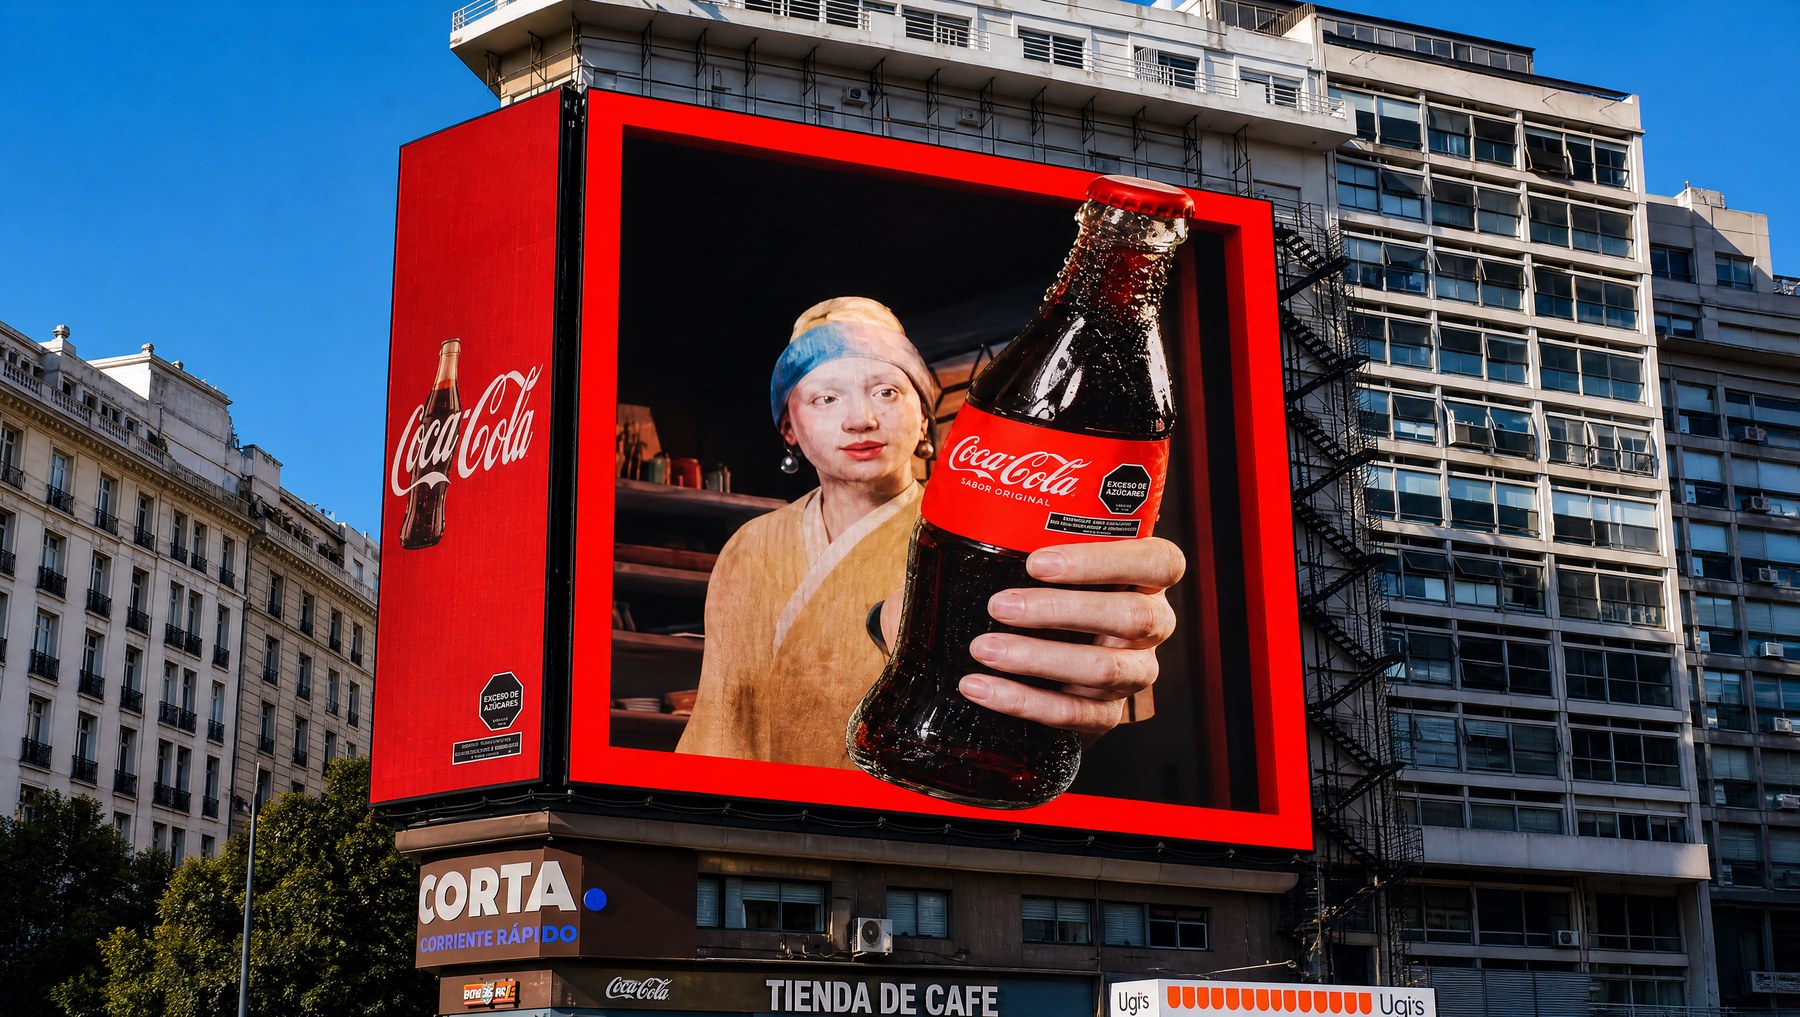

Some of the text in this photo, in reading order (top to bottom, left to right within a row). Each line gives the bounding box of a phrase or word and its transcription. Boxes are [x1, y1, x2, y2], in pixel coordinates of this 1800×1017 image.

[391, 363, 544, 497] Coca-Cola
[948, 435, 1093, 497] Coca-Cola
[960, 476, 1051, 507] SABOR ORIGINAL
[1105, 488, 1145, 498] AZÚCARES
[1107, 481, 1137, 489] EXCESO
[483, 690, 519, 703] EXCESO DE
[483, 699, 519, 712] AZÚCARES
[418, 860, 578, 925] CORTA
[420, 922, 578, 953] CORRIENTE RÁPIDO
[605, 976, 674, 1001] Coca-Cola
[766, 979, 998, 1017] TIENDA DE CAFE
[1118, 991, 1150, 1016] Ugi's
